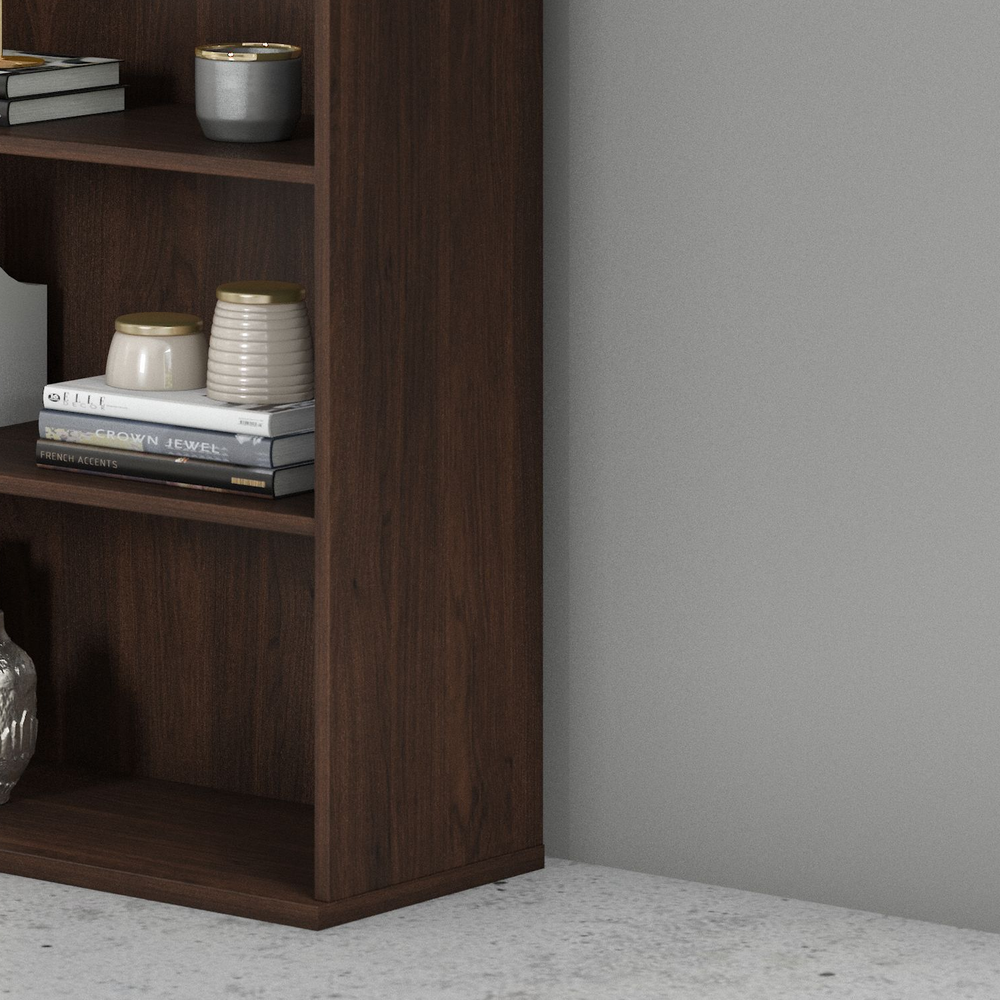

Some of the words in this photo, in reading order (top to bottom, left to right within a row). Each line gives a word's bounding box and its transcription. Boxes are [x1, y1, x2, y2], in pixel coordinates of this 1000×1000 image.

[95, 428, 159, 446] CROWN
[165, 437, 220, 455] JEWEL
[40, 450, 75, 463] FRENCH
[77, 456, 118, 469] ACCENTS
